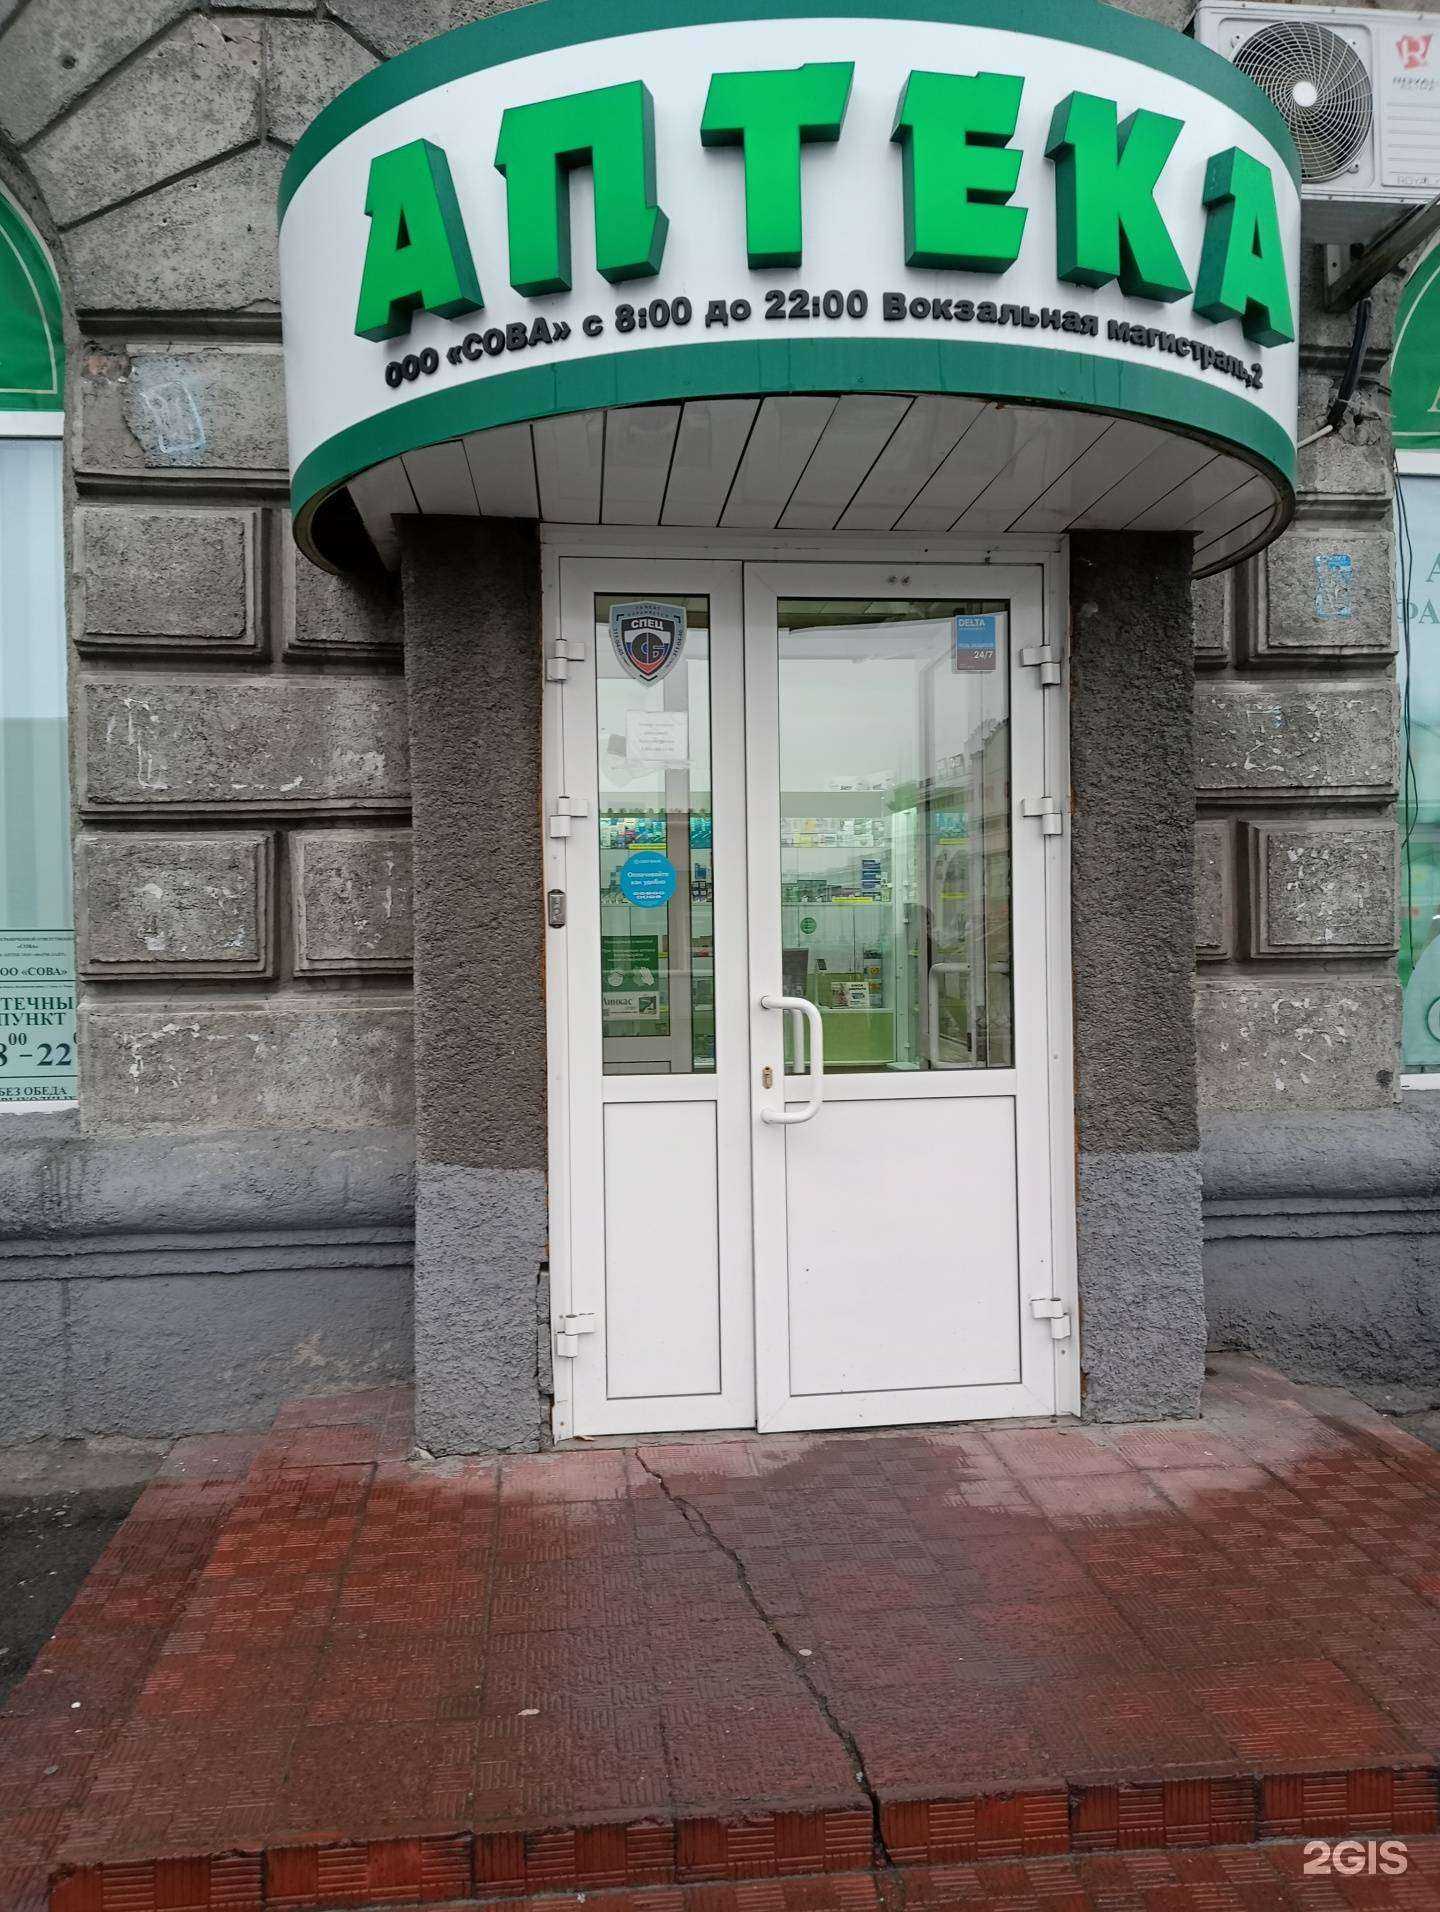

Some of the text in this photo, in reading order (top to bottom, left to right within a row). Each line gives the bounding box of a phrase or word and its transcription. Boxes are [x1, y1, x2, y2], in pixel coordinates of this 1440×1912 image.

[355, 61, 1295, 348] АПТЕКА
[385, 346, 439, 388] ООО
[446, 317, 571, 365] «СОВА»
[615, 297, 692, 333] 8:00
[705, 299, 751, 328] до
[765, 289, 868, 319] 22:00
[883, 292, 1099, 336] Вокзальная
[631, 619, 664, 631] СПЕЦ
[958, 618, 986, 627] DELTA
[973, 650, 994, 659] 24/7
[21, 965, 68, 976] «СОВА»
[0, 1012, 66, 1026] ПУНКТ
[23, 1085, 68, 1096] ОБЕДА
